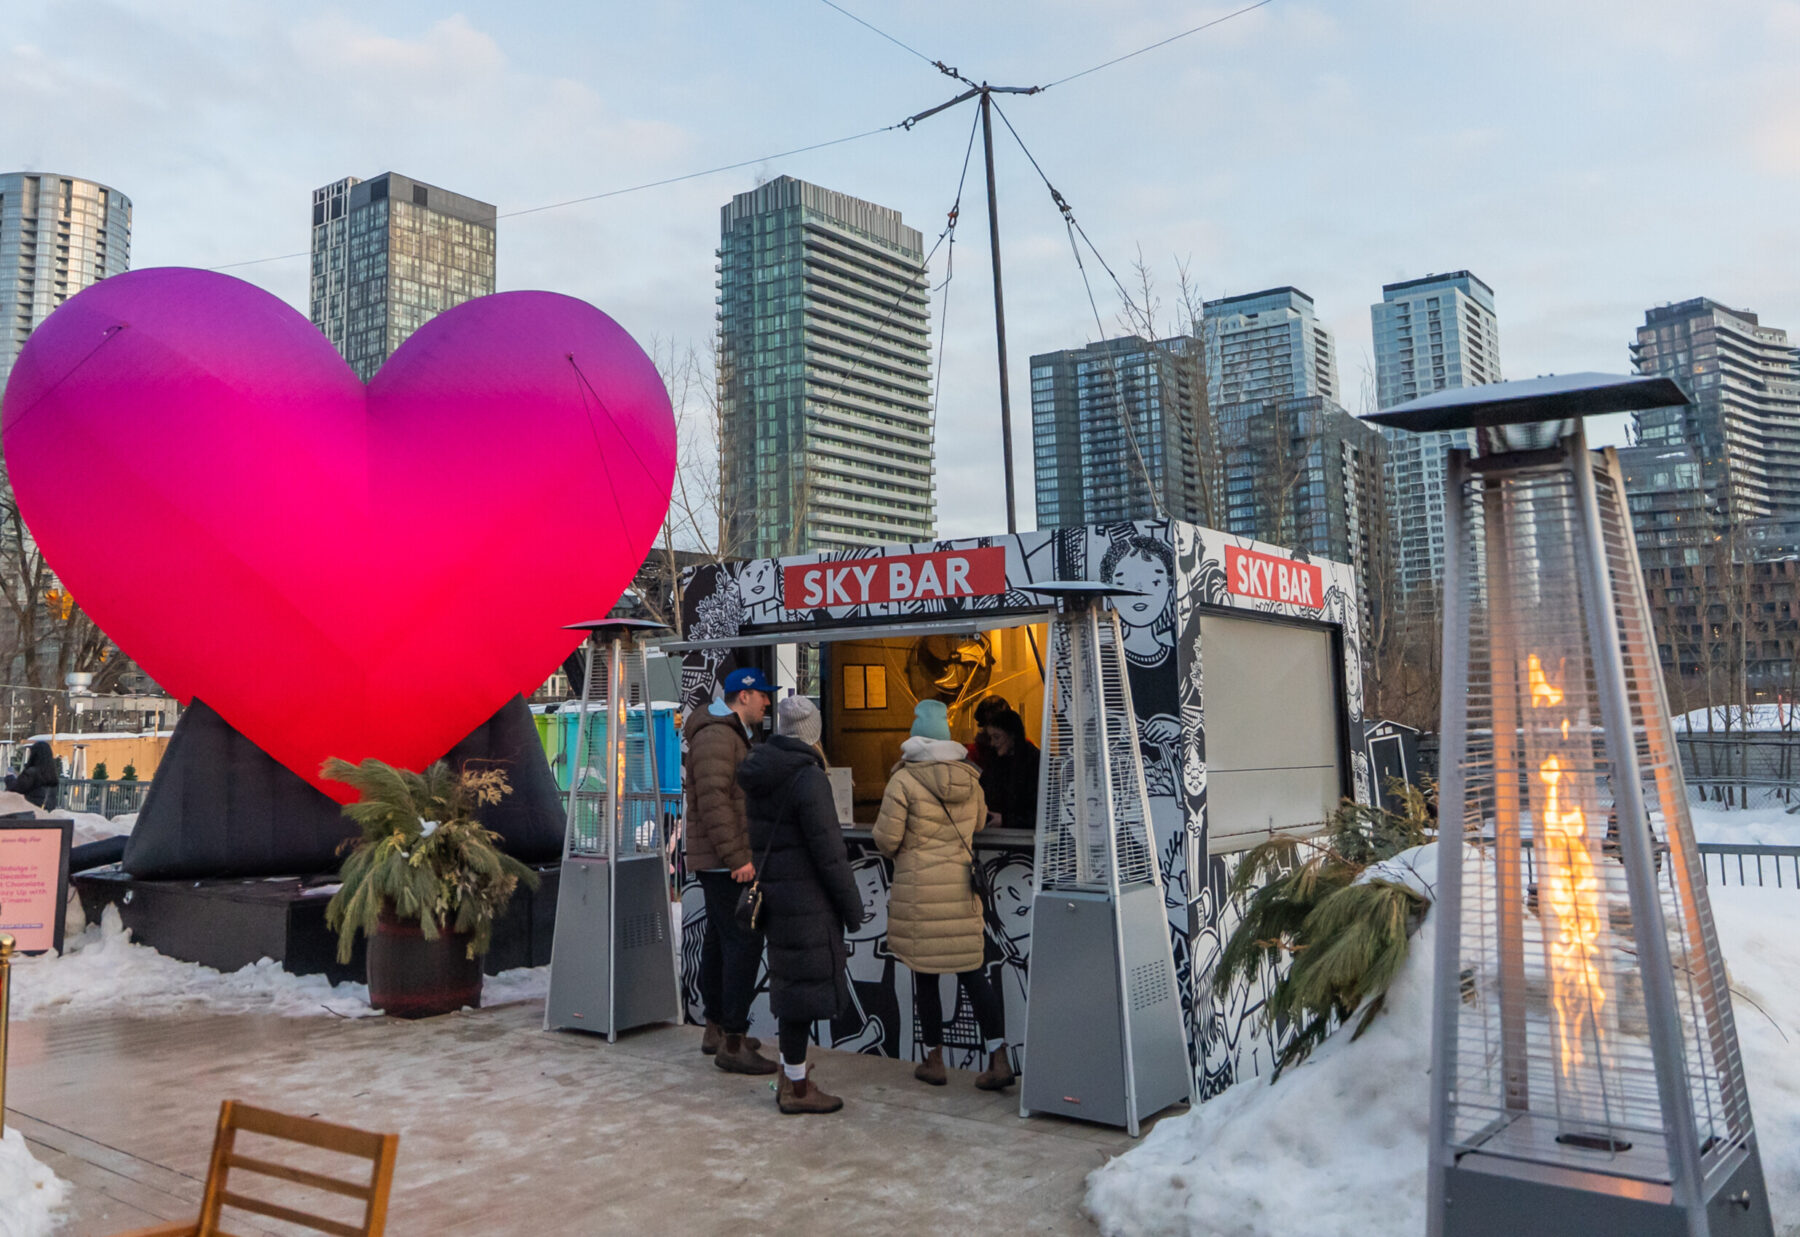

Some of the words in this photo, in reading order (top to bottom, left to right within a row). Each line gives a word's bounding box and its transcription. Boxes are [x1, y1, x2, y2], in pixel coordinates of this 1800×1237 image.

[803, 564, 878, 606] SKY
[889, 557, 974, 600] BAR
[1236, 554, 1274, 597] SKY
[1278, 563, 1314, 605] BAR
